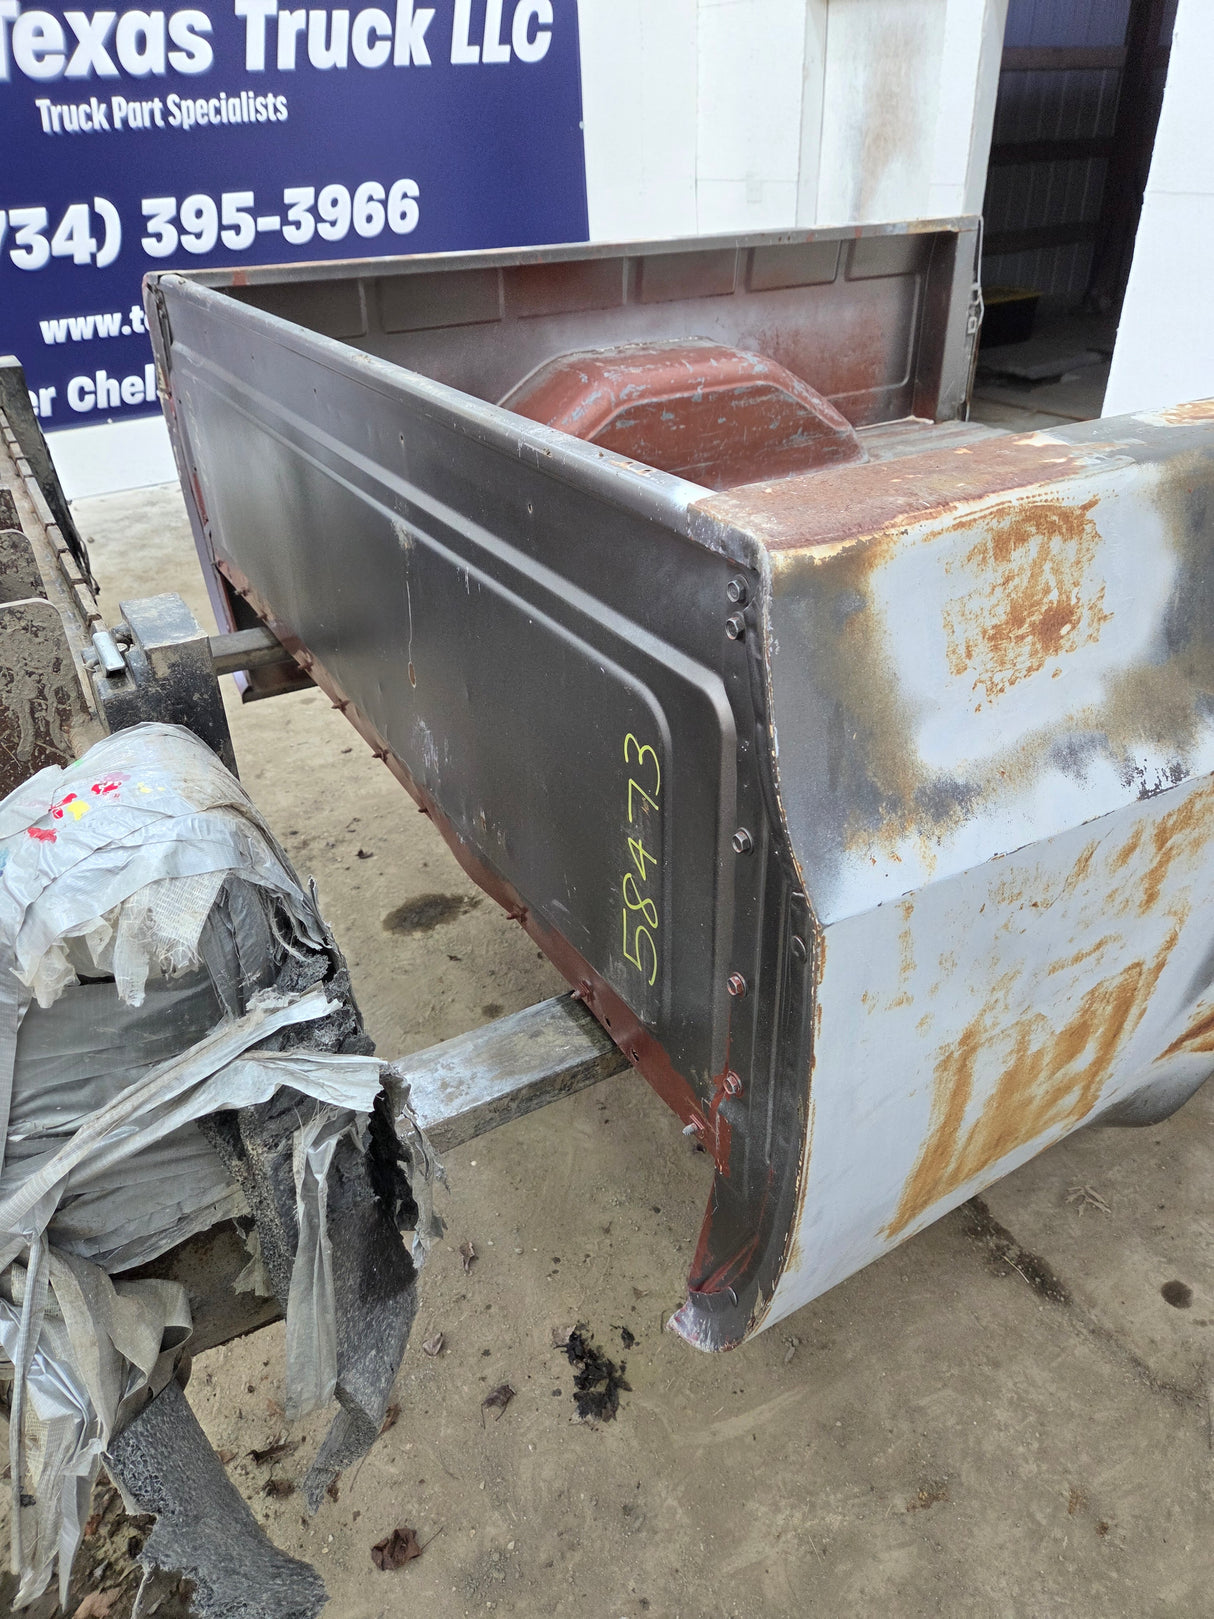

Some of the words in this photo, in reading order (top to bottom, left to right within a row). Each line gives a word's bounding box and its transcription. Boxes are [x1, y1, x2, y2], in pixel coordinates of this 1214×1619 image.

[235, 0, 437, 71] Truck
[450, 0, 554, 65] LLC
[35, 98, 110, 133] Truck
[111, 95, 165, 130] Part
[166, 91, 289, 130] Specialists
[0, 196, 122, 271] 34)
[141, 178, 420, 258] 395-3966
[39, 305, 152, 345] www.t
[66, 363, 162, 412] Chel
